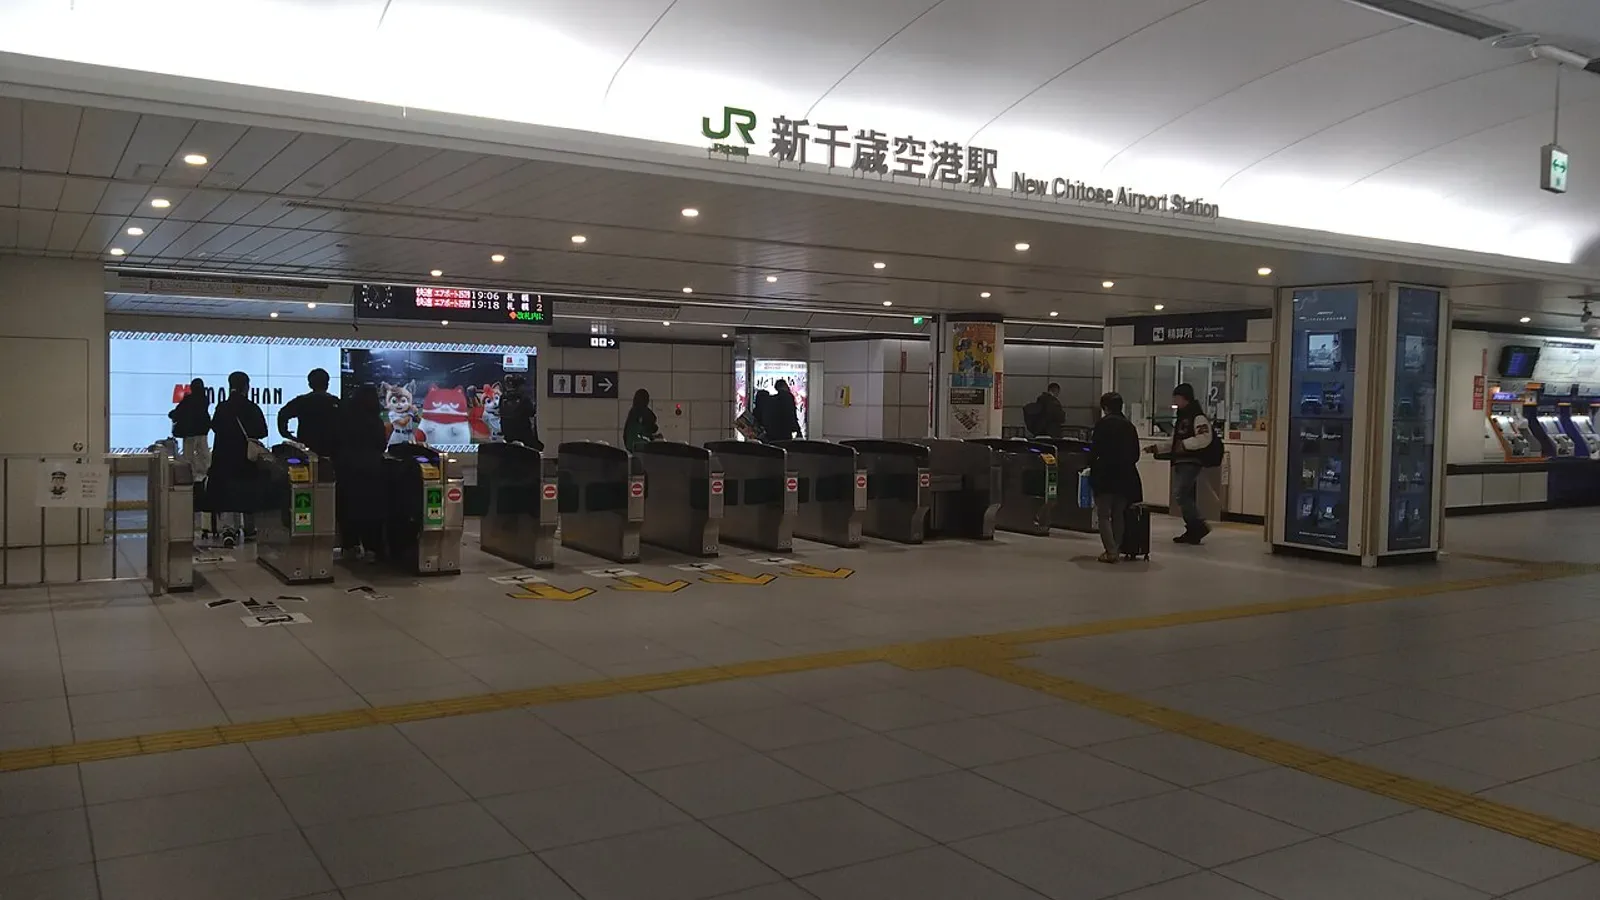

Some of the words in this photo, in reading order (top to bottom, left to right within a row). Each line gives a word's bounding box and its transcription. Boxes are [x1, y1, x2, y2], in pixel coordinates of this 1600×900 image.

[702, 106, 756, 144] JR
[769, 115, 998, 188] 新千歳空港駅
[1012, 171, 1049, 196] New
[1052, 177, 1114, 204] Chitose
[1114, 186, 1168, 214] Airport
[1170, 194, 1219, 218] Station
[472, 291, 500, 300] 19:06
[472, 300, 500, 309] 19:18
[536, 304, 543, 312] 2
[1210, 386, 1219, 402] 2
